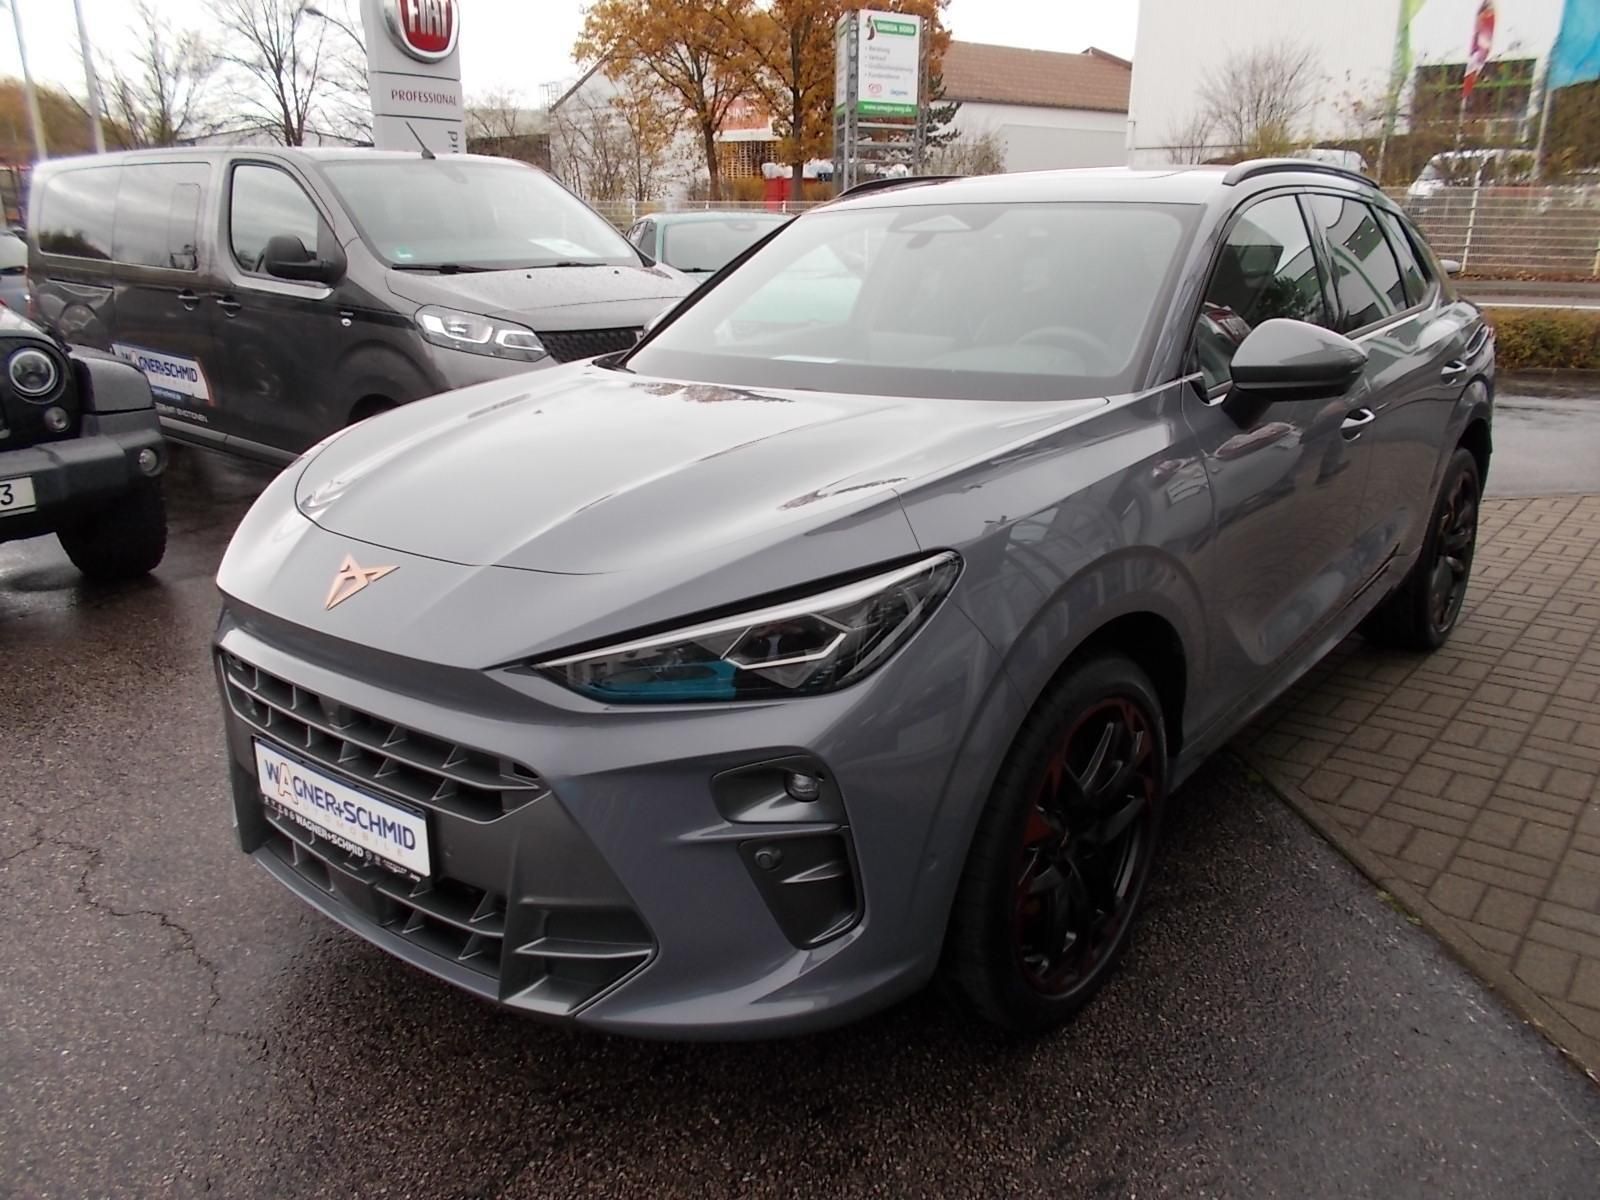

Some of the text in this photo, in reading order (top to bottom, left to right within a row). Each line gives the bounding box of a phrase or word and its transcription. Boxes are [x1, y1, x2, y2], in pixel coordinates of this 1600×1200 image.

[407, 0, 450, 37] FIAT
[391, 89, 456, 105] PROFESSIONAL
[264, 759, 416, 850] WAGNER+SCHMID
